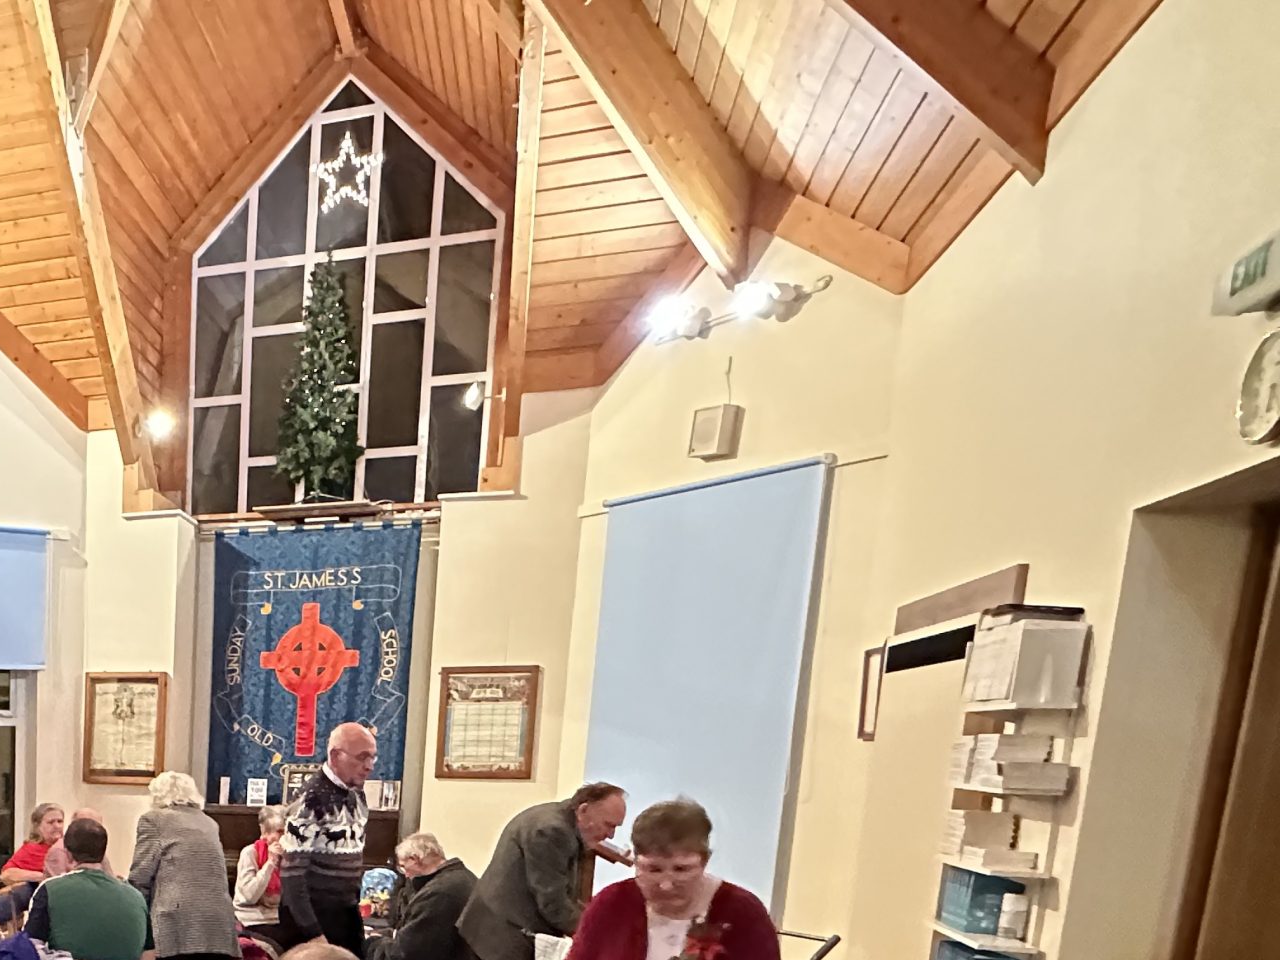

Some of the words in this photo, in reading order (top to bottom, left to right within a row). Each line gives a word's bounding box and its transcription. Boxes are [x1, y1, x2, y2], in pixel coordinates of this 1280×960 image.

[227, 626, 246, 686] SUNDAY
[377, 628, 397, 685] SCHOOL
[247, 724, 273, 746] OLD
